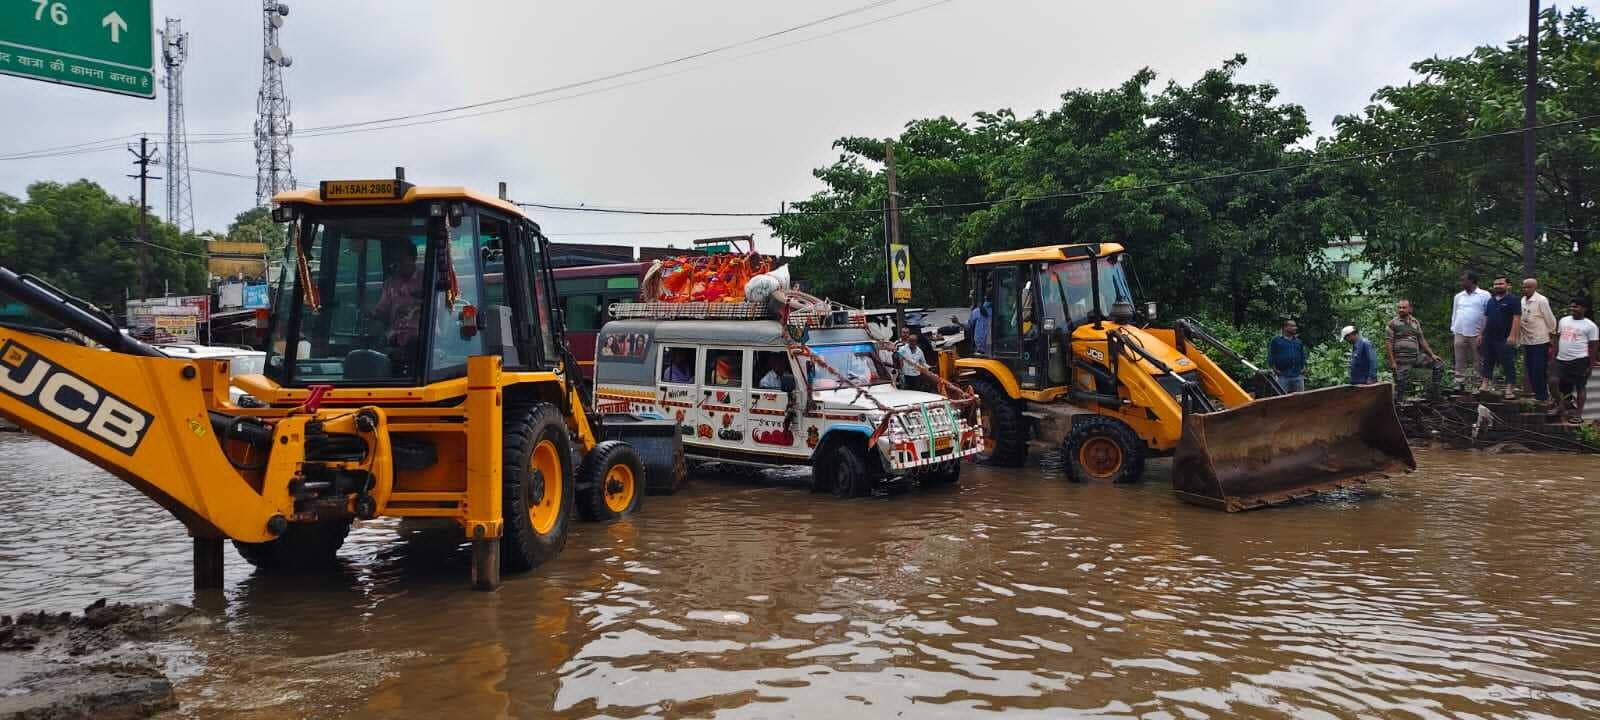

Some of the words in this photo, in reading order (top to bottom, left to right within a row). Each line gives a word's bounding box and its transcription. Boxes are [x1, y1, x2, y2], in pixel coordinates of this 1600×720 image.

[31, 0, 69, 26] 76
[17, 55, 43, 69] यात्रा
[50, 58, 65, 73] की
[70, 64, 104, 80] कामना
[110, 71, 136, 85] करता
[1087, 348, 1104, 361] JCB
[0, 359, 146, 449] JCB
